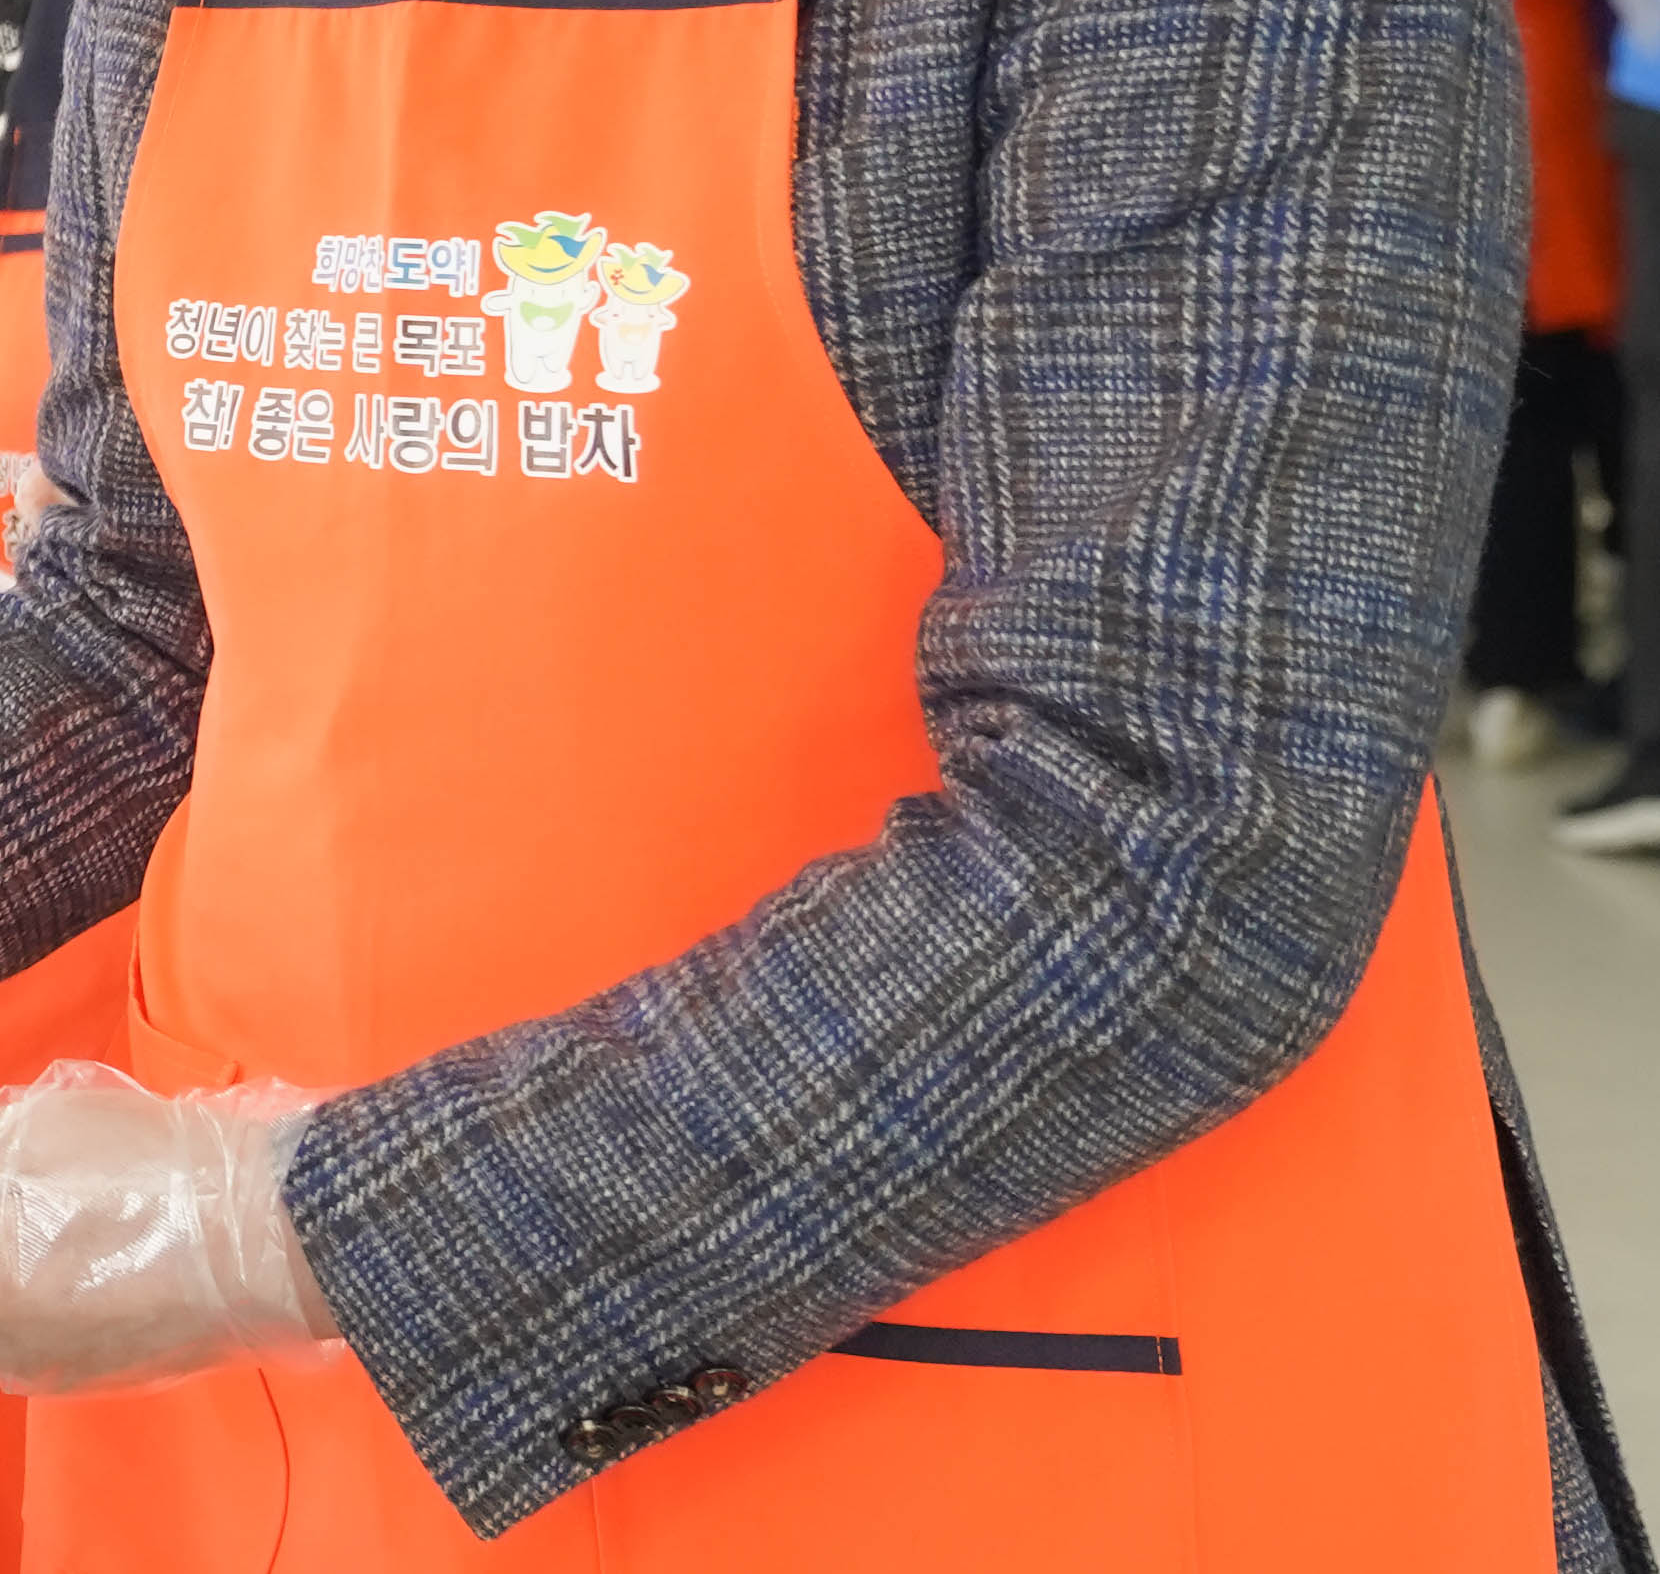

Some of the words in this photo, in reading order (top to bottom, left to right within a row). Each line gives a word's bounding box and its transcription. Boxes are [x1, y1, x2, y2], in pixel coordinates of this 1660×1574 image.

[167, 300, 275, 366] 청년이
[284, 308, 345, 371] 찾는
[352, 314, 382, 373] 큰
[394, 315, 486, 377] 목포
[181, 379, 243, 452] 참!
[249, 386, 334, 464] 좋은
[345, 395, 497, 476] 사랑의
[518, 401, 641, 482] 밥차
